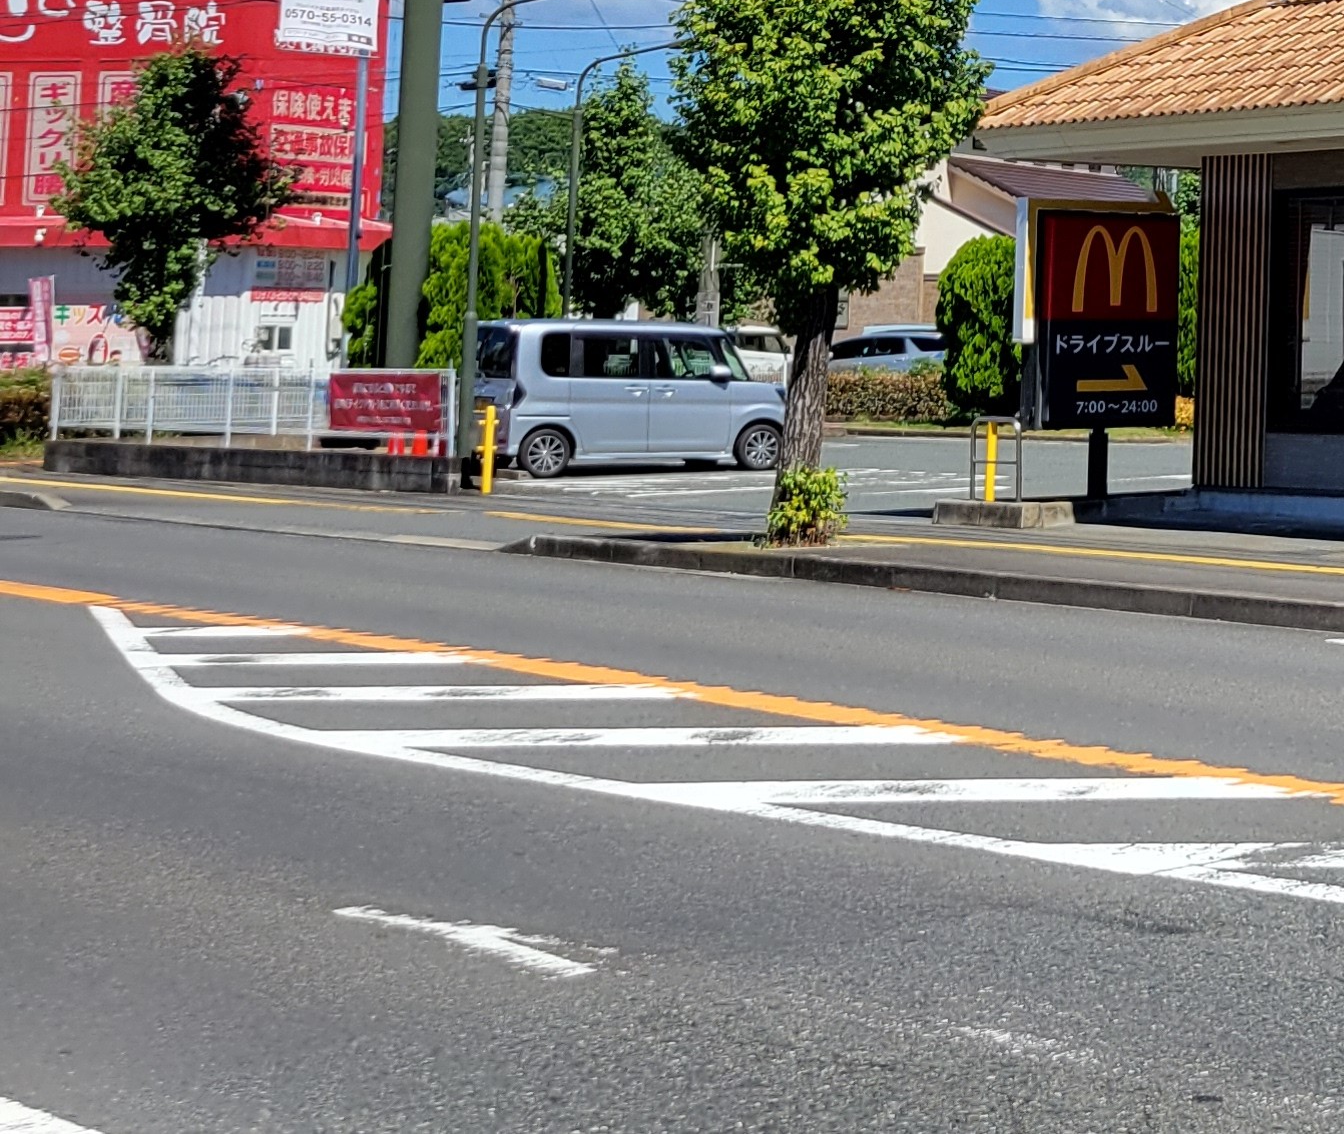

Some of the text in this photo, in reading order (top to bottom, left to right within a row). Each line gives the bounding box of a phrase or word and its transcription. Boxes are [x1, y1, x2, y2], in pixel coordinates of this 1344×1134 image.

[83, 0, 226, 44] 整骨院
[285, 8, 372, 27] 0570-55-0314
[272, 89, 366, 124] 保険使えま
[1056, 333, 1170, 355] ドライブスルー
